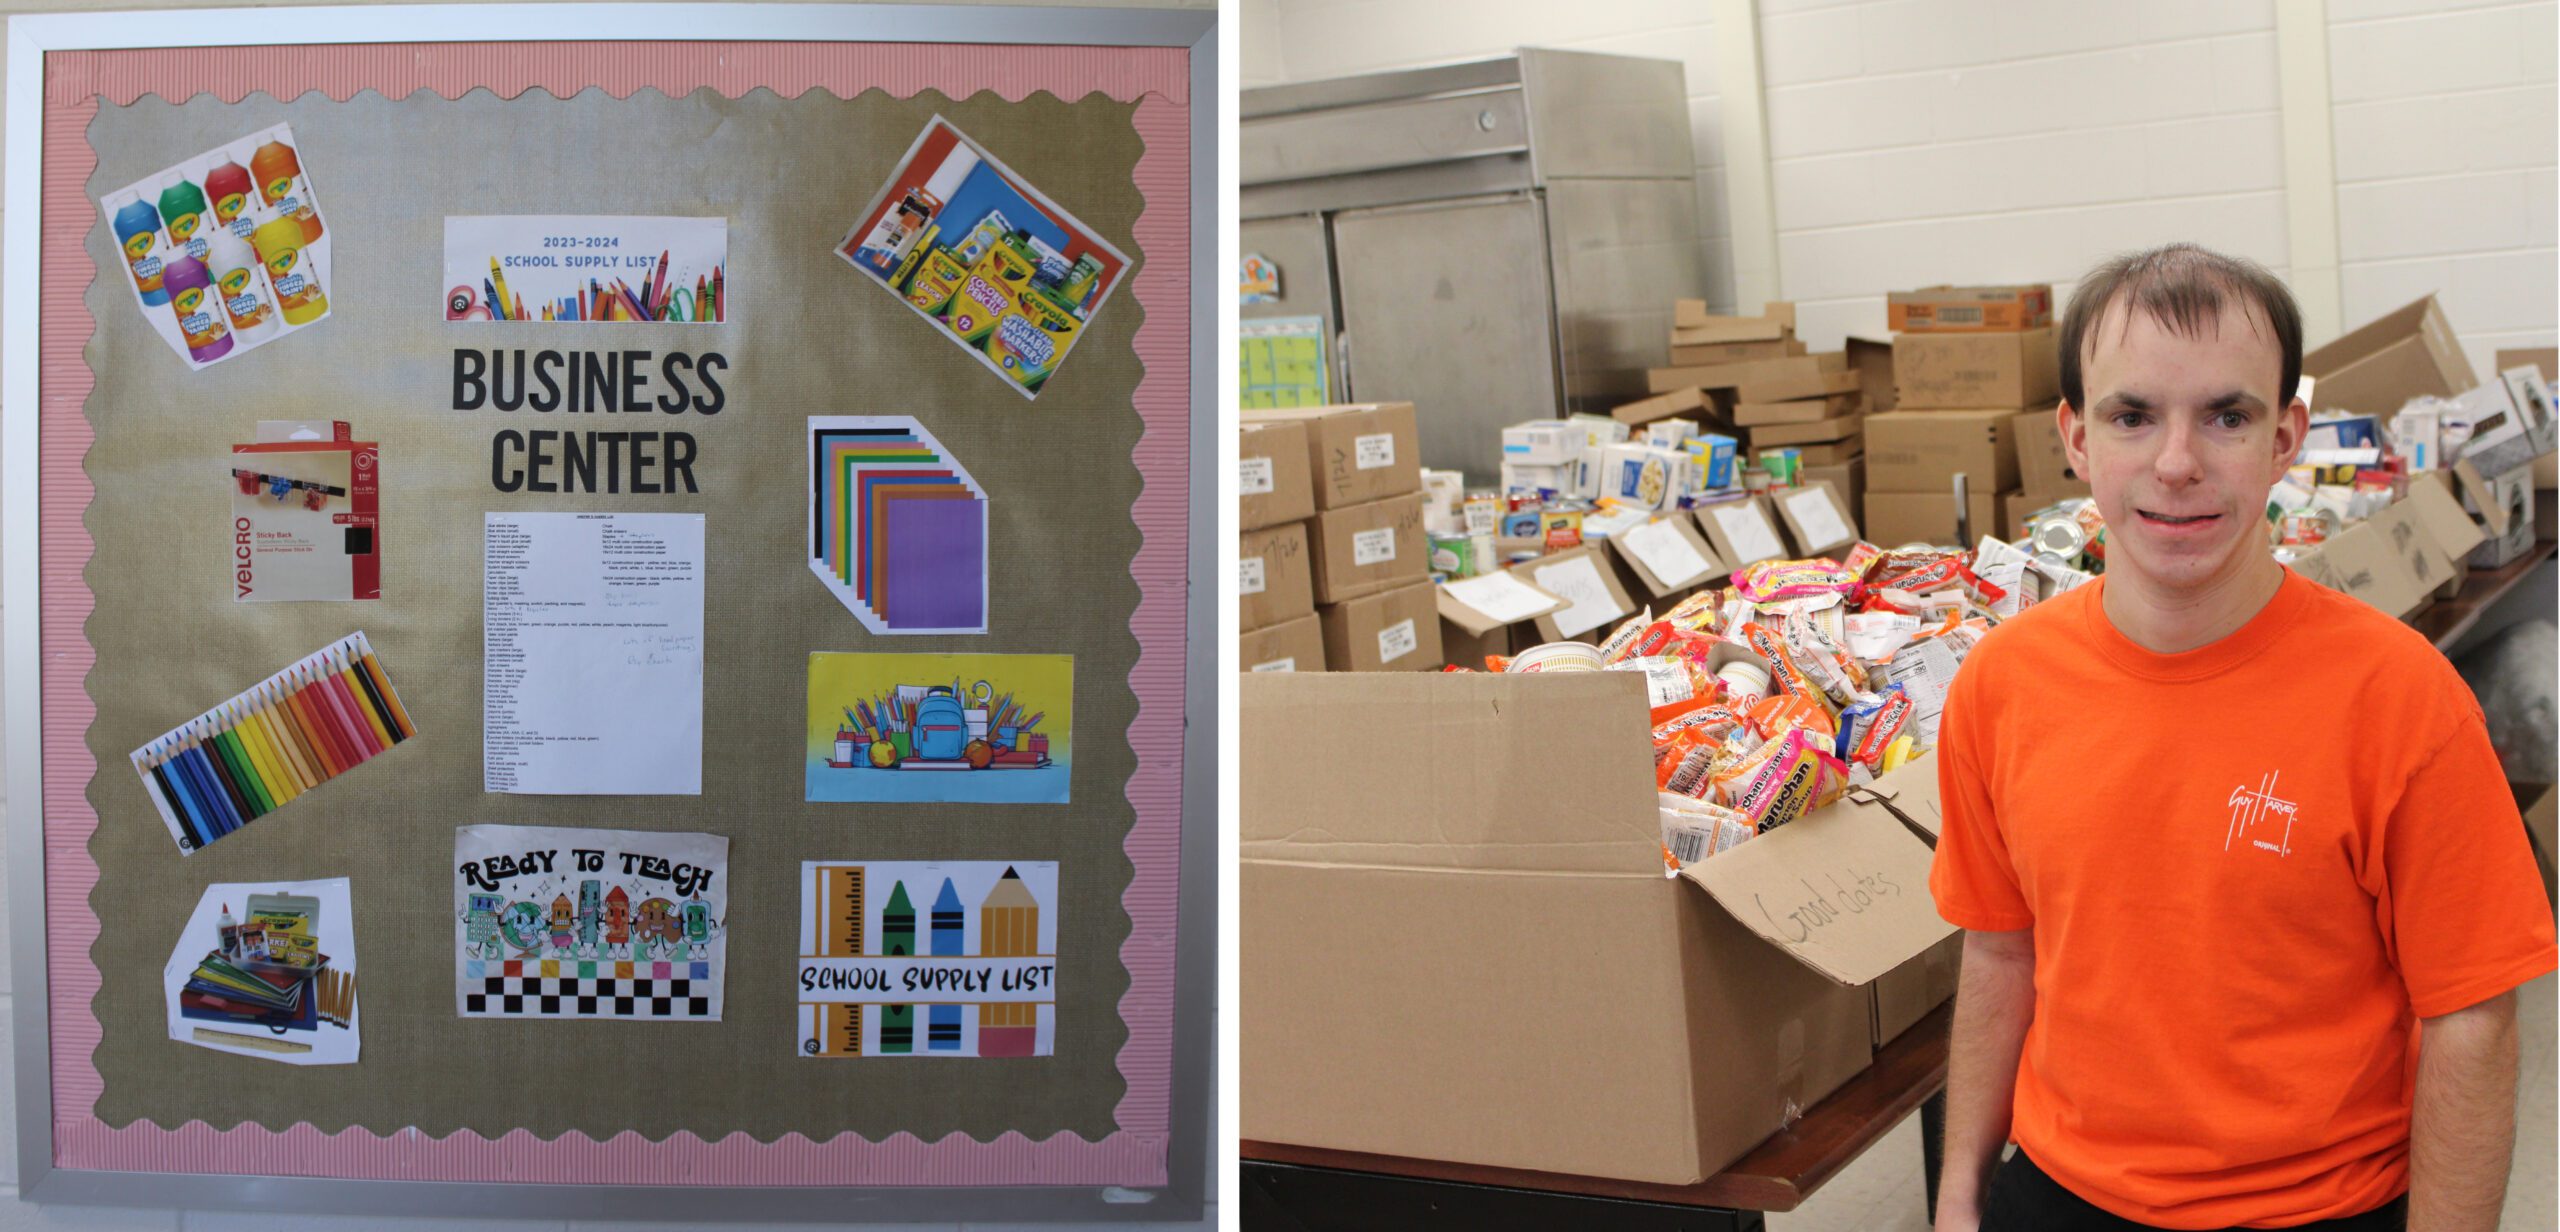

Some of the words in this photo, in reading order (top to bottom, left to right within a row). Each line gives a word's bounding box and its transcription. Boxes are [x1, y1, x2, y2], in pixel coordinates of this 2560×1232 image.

[543, 237, 619, 248] 2023-2024
[504, 256, 558, 267] SCHOOL
[565, 256, 618, 267] SUPPLY
[625, 256, 657, 268] LIST
[965, 285, 1001, 317] PENCILS
[969, 275, 1009, 310] COLORED
[1023, 291, 1069, 327] Crayola
[1000, 328, 1042, 366] MARKERS
[1001, 316, 1055, 361] WASHABLE
[452, 348, 728, 415] BUSINESS
[491, 430, 699, 493] CENTER
[256, 532, 275, 540] Sticky
[1612, 624, 1642, 649] Ramen
[1631, 631, 1662, 657] Ramen
[1761, 637, 1788, 680] Maruchan
[1785, 678, 1800, 700] Ram
[1741, 780, 1763, 810] chan
[1763, 741, 1792, 779] Ramen
[1793, 786, 1813, 812] Soup
[2225, 785, 2254, 852] GUY
[2246, 769, 2298, 857] HARVEY
[619, 852, 713, 897] TEACH
[1755, 878, 1839, 943] Good
[1825, 868, 1901, 914] dates
[800, 966, 891, 992] SCHOOL
[903, 966, 992, 993] SUPPLY
[1002, 965, 1054, 992] LIST
